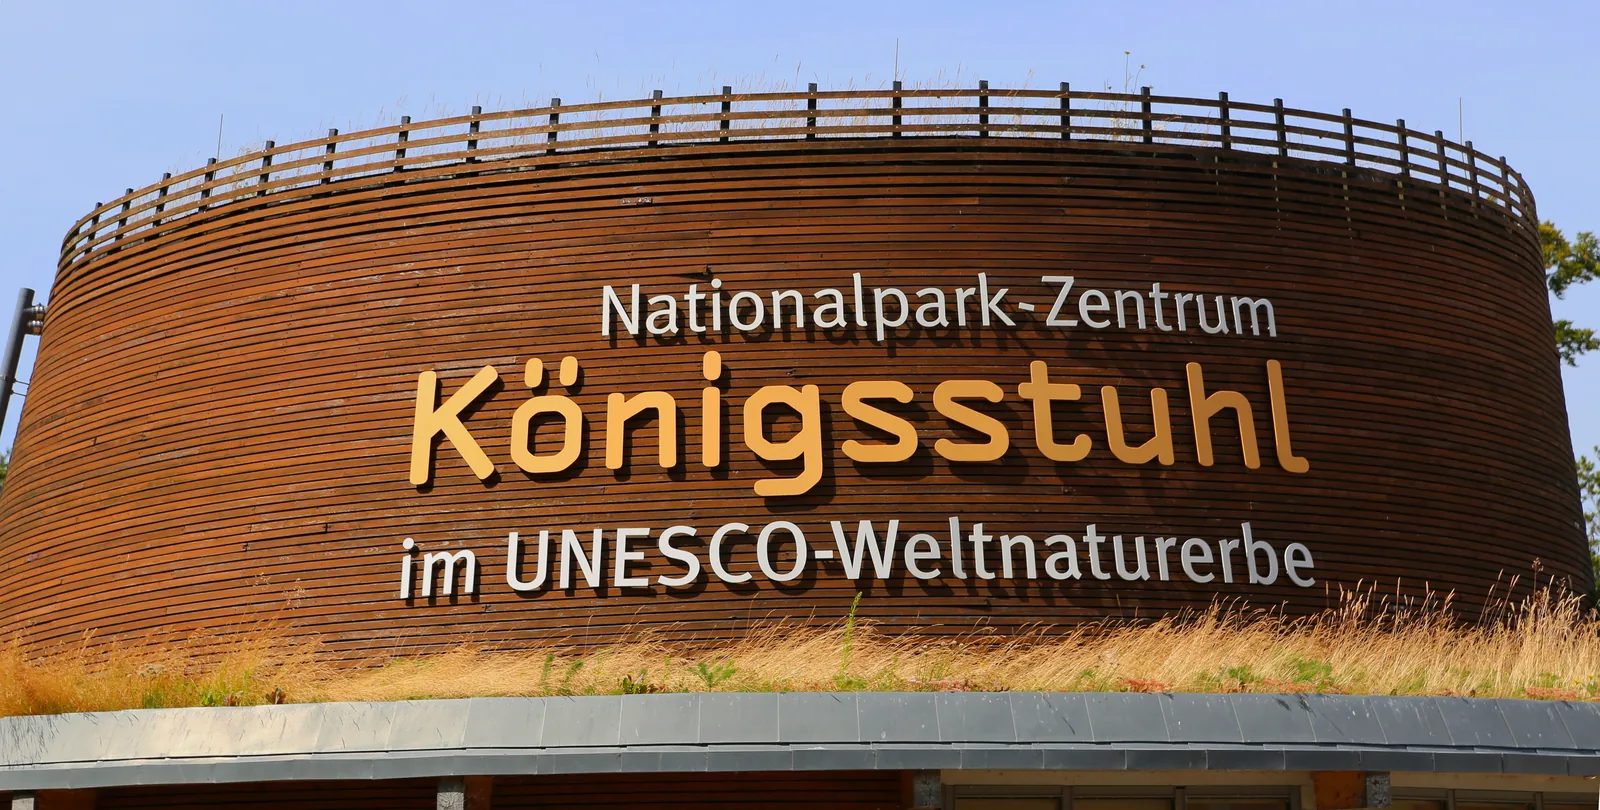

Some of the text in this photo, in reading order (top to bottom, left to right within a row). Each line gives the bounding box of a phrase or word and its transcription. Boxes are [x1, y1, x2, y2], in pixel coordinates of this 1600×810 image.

[601, 272, 1277, 341] Nationalpark-Zentrum
[409, 350, 1309, 497] Königsstuhl
[400, 516, 1316, 599] im UNESCO-Weltnaturerbe
